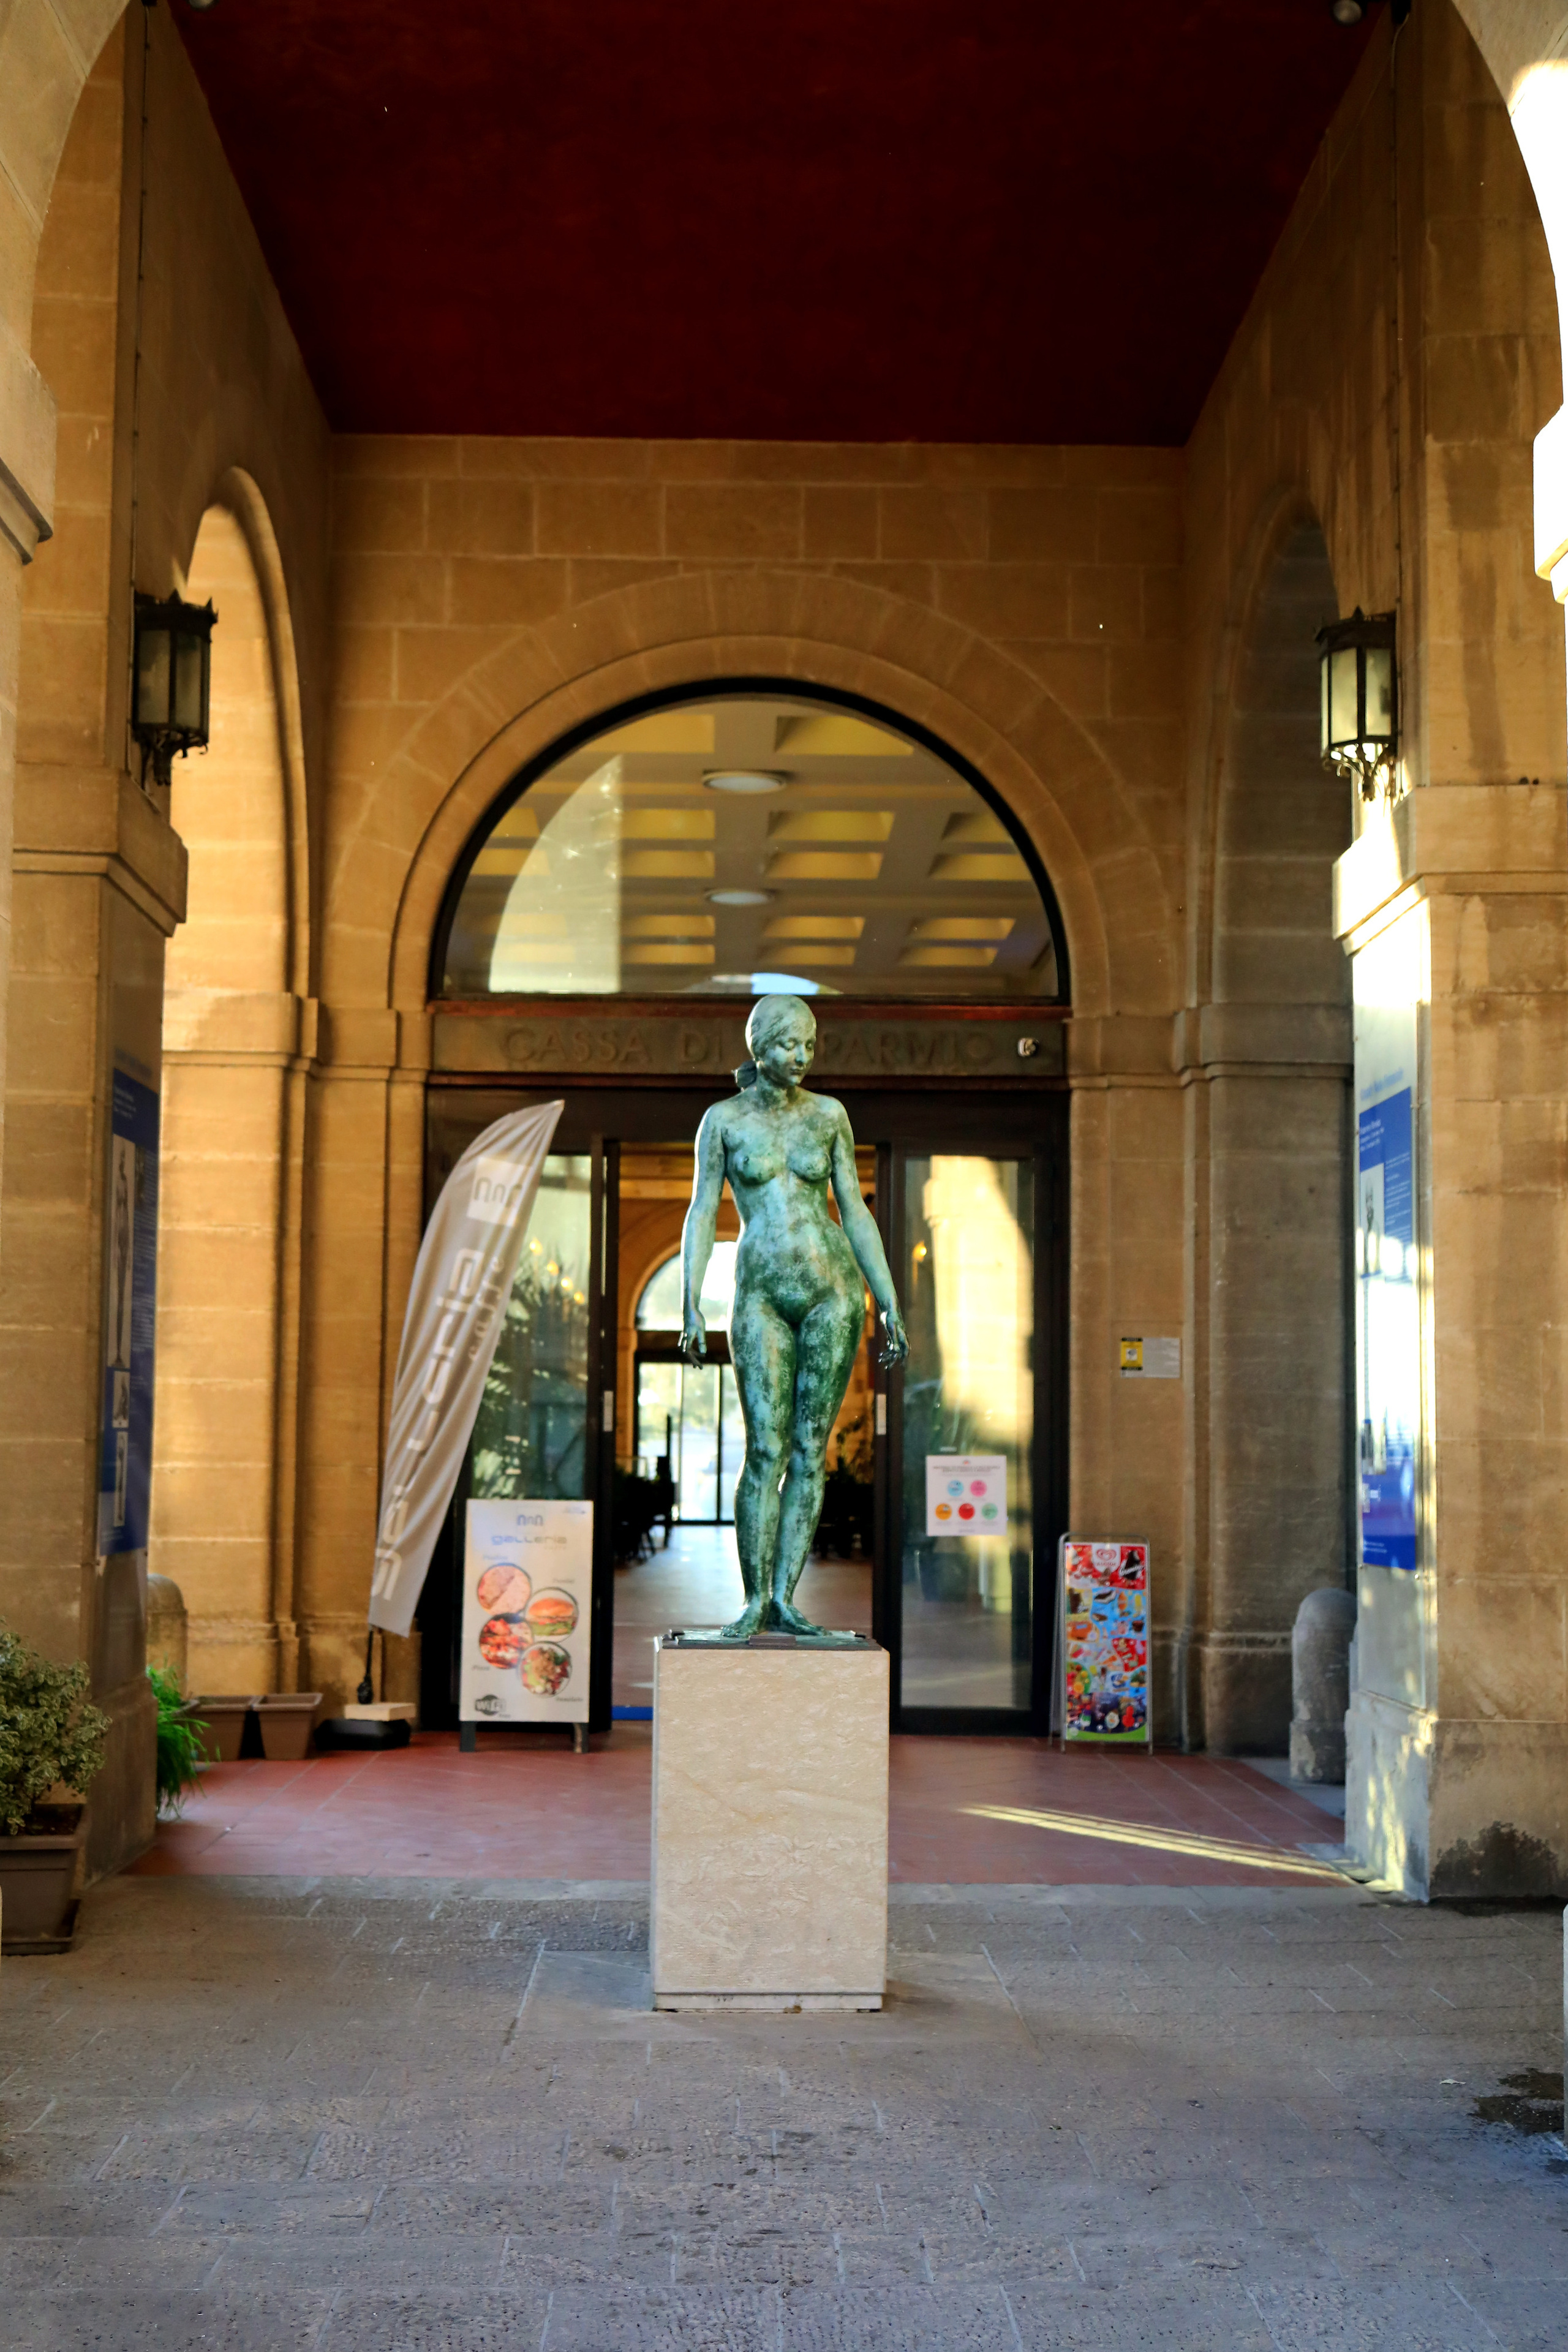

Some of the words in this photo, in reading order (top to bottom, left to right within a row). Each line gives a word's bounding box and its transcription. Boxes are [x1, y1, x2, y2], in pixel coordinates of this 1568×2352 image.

[500, 1027, 652, 1063] CASSA
[680, 1025, 723, 1064] DI
[820, 1031, 996, 1066] PARMIO
[491, 1536, 567, 1545] galleria
